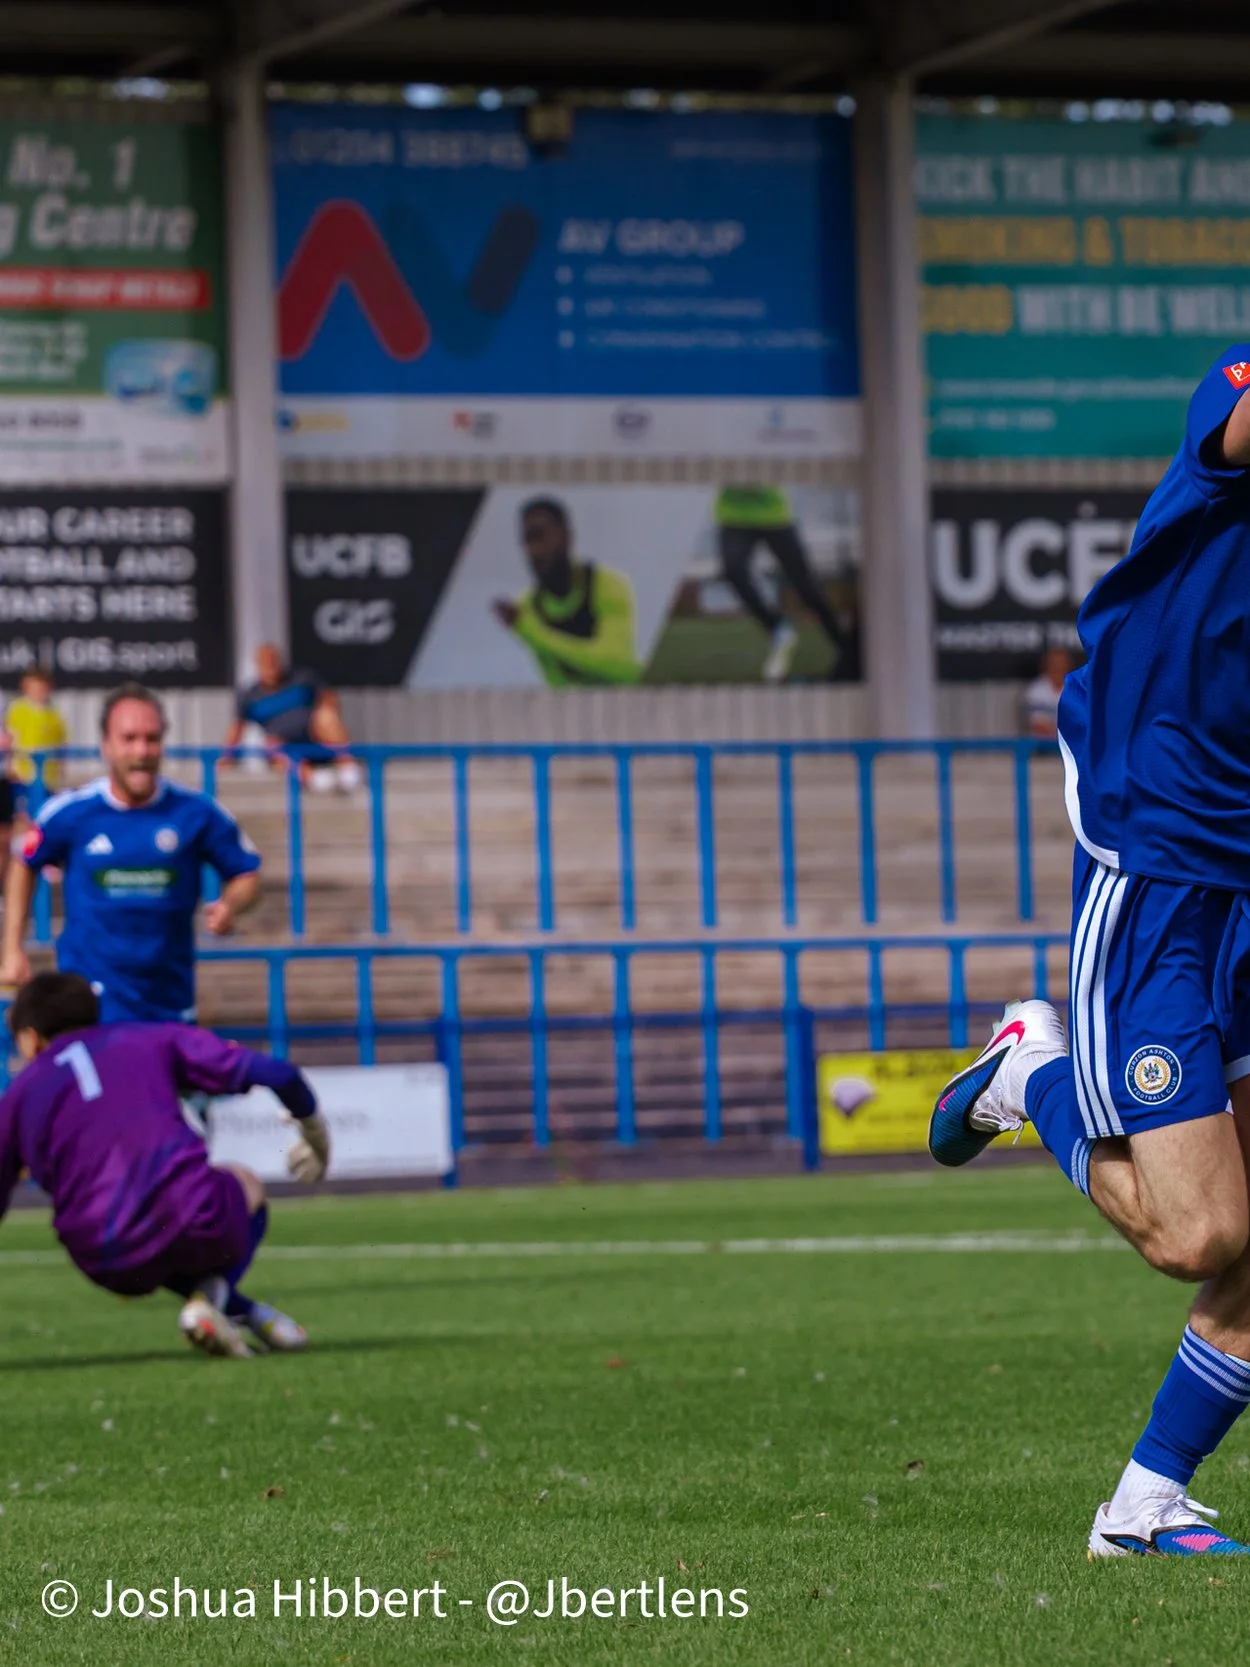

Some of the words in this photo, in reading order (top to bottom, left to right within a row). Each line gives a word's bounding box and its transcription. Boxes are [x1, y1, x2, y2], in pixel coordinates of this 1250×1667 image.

[1001, 156, 1067, 203] THE
[1073, 156, 1182, 204] HABIT
[30, 192, 198, 251] Centre
[616, 218, 745, 259] GROUP
[53, 507, 194, 543] CAREER
[116, 546, 197, 583] AND
[292, 533, 413, 579] UCFB
[933, 518, 1138, 610] UCF
[101, 586, 198, 622] HERE
[313, 600, 397, 645] GIS
[53, 1040, 103, 1102] 1
[1128, 1050, 1148, 1076] CURZON
[1148, 1048, 1175, 1065] ASHTON
[1132, 1086, 1166, 1101] FOOTBALL
[1165, 1076, 1178, 1094] CLUB
